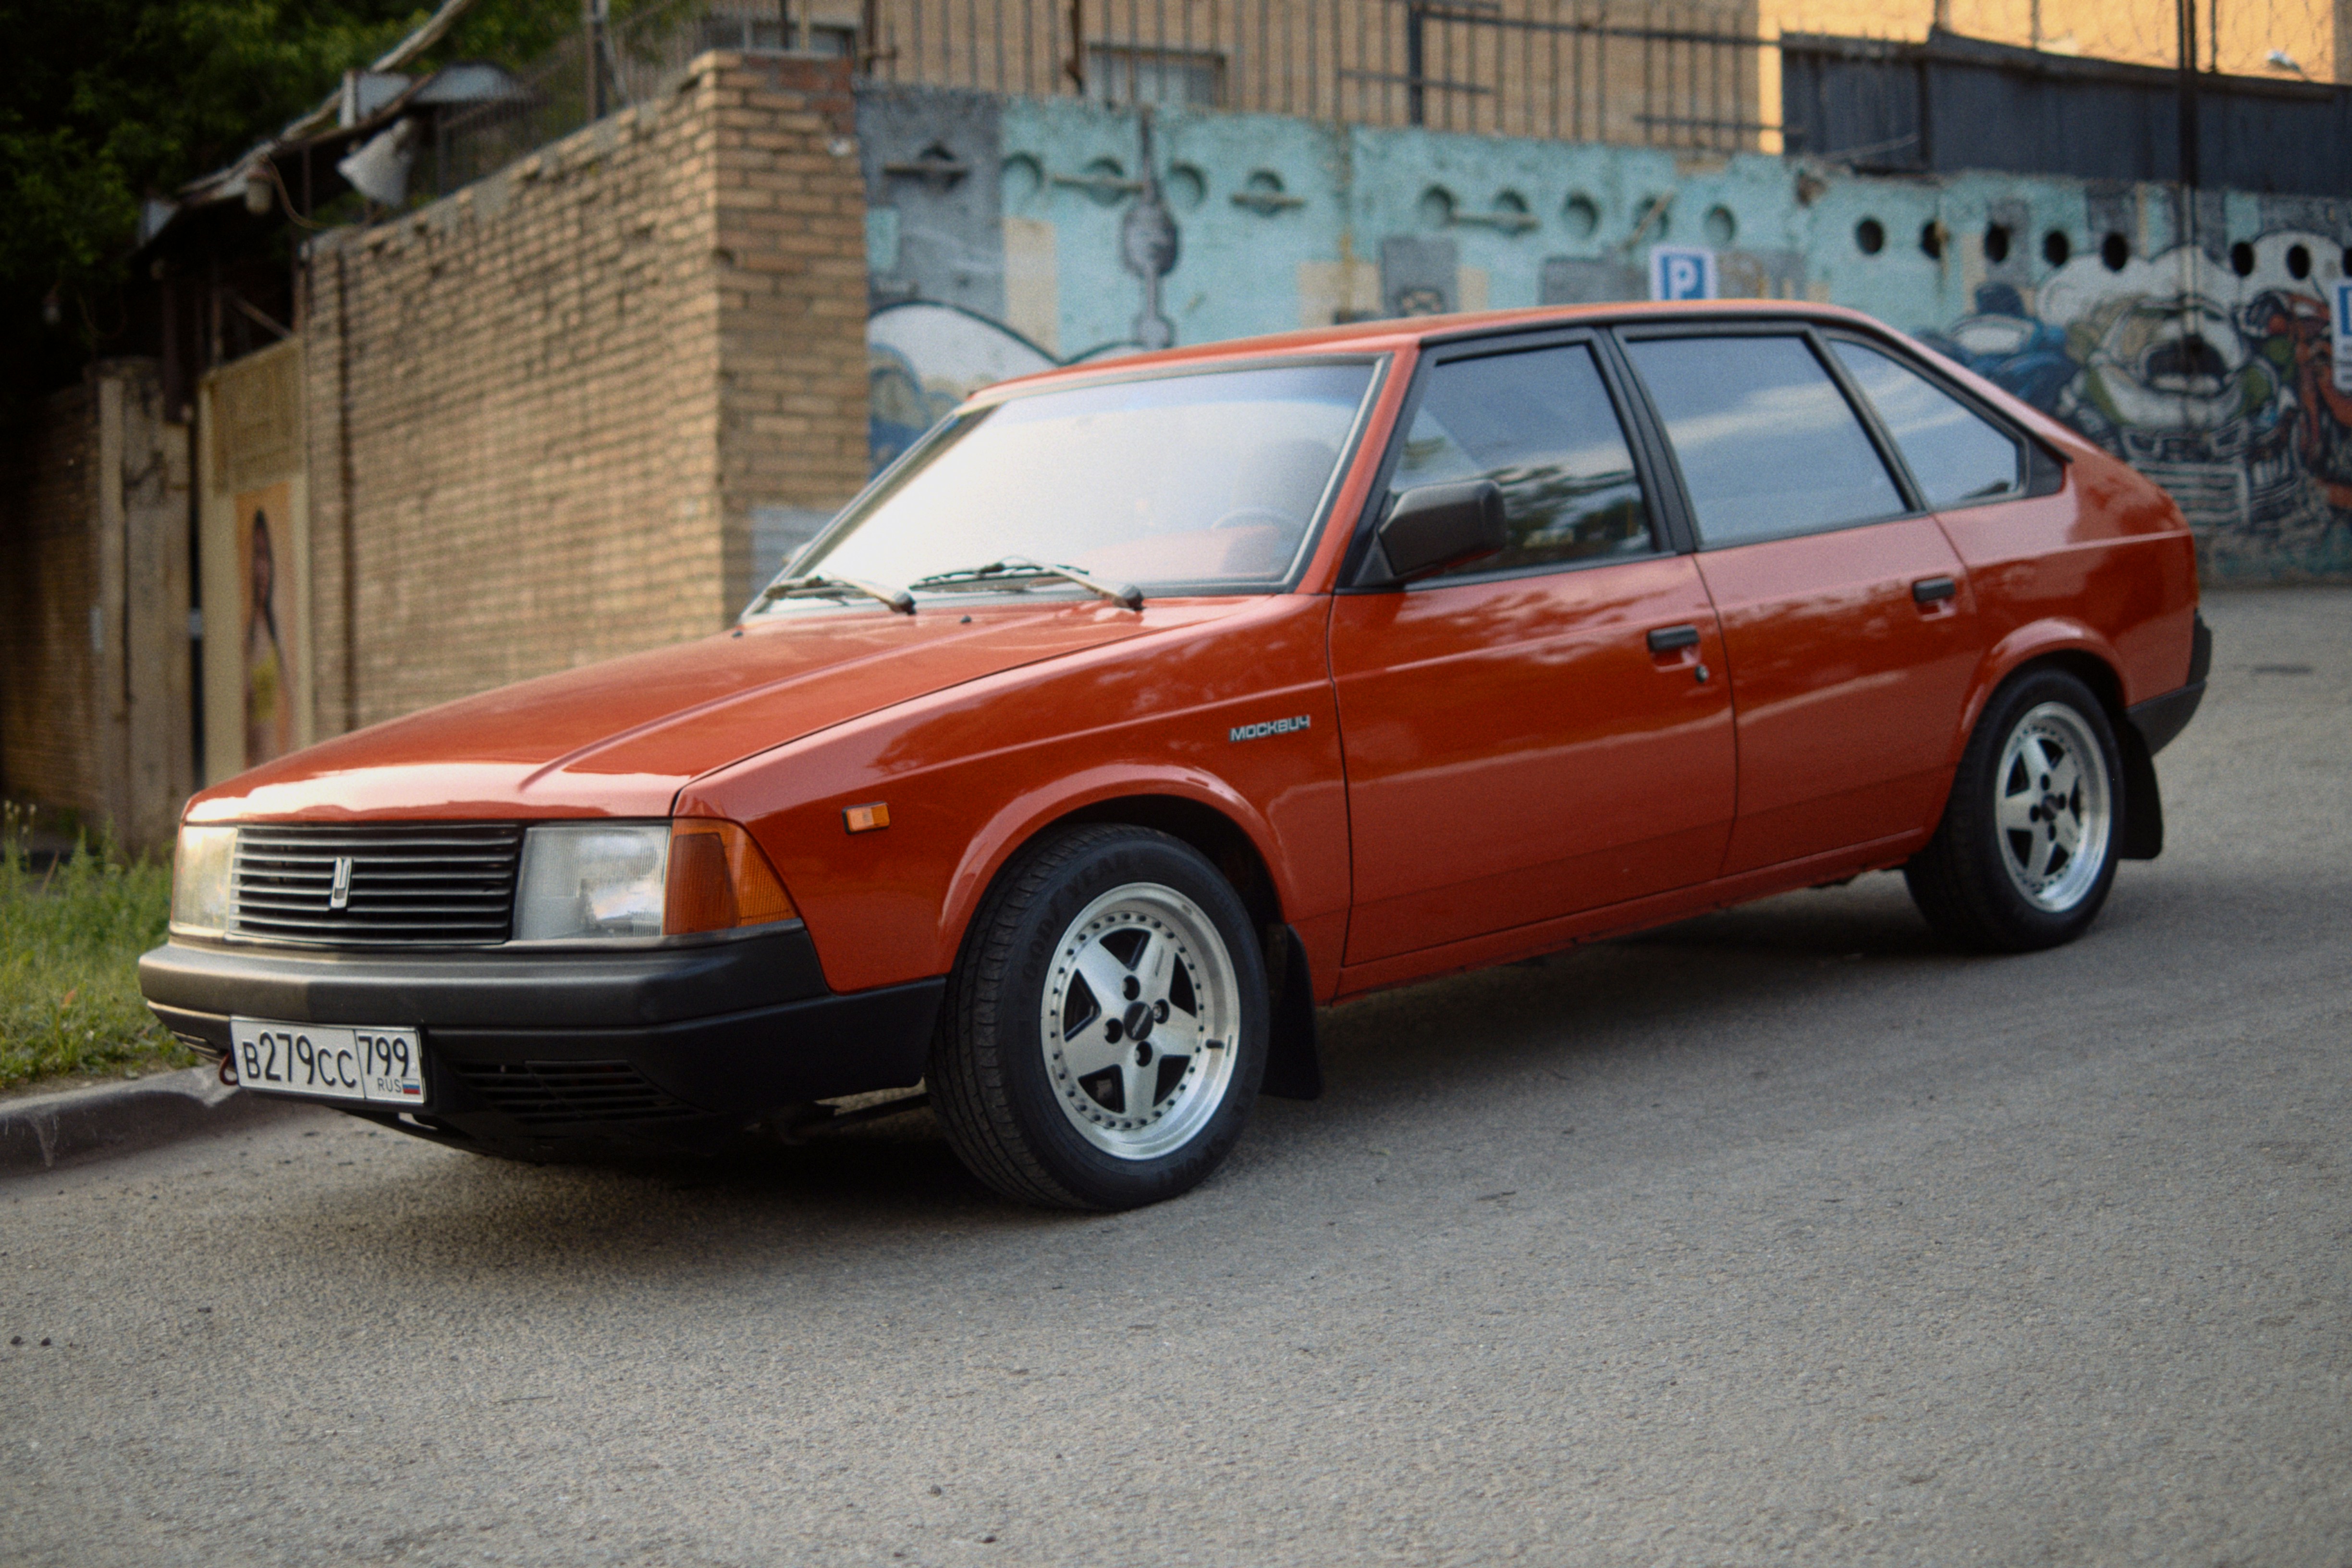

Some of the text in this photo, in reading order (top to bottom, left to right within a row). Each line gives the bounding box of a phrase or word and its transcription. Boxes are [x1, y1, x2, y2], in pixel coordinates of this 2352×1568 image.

[1669, 258, 1698, 301] P
[242, 1031, 409, 1088] В279СС 799
[377, 1078, 402, 1093] RUS
